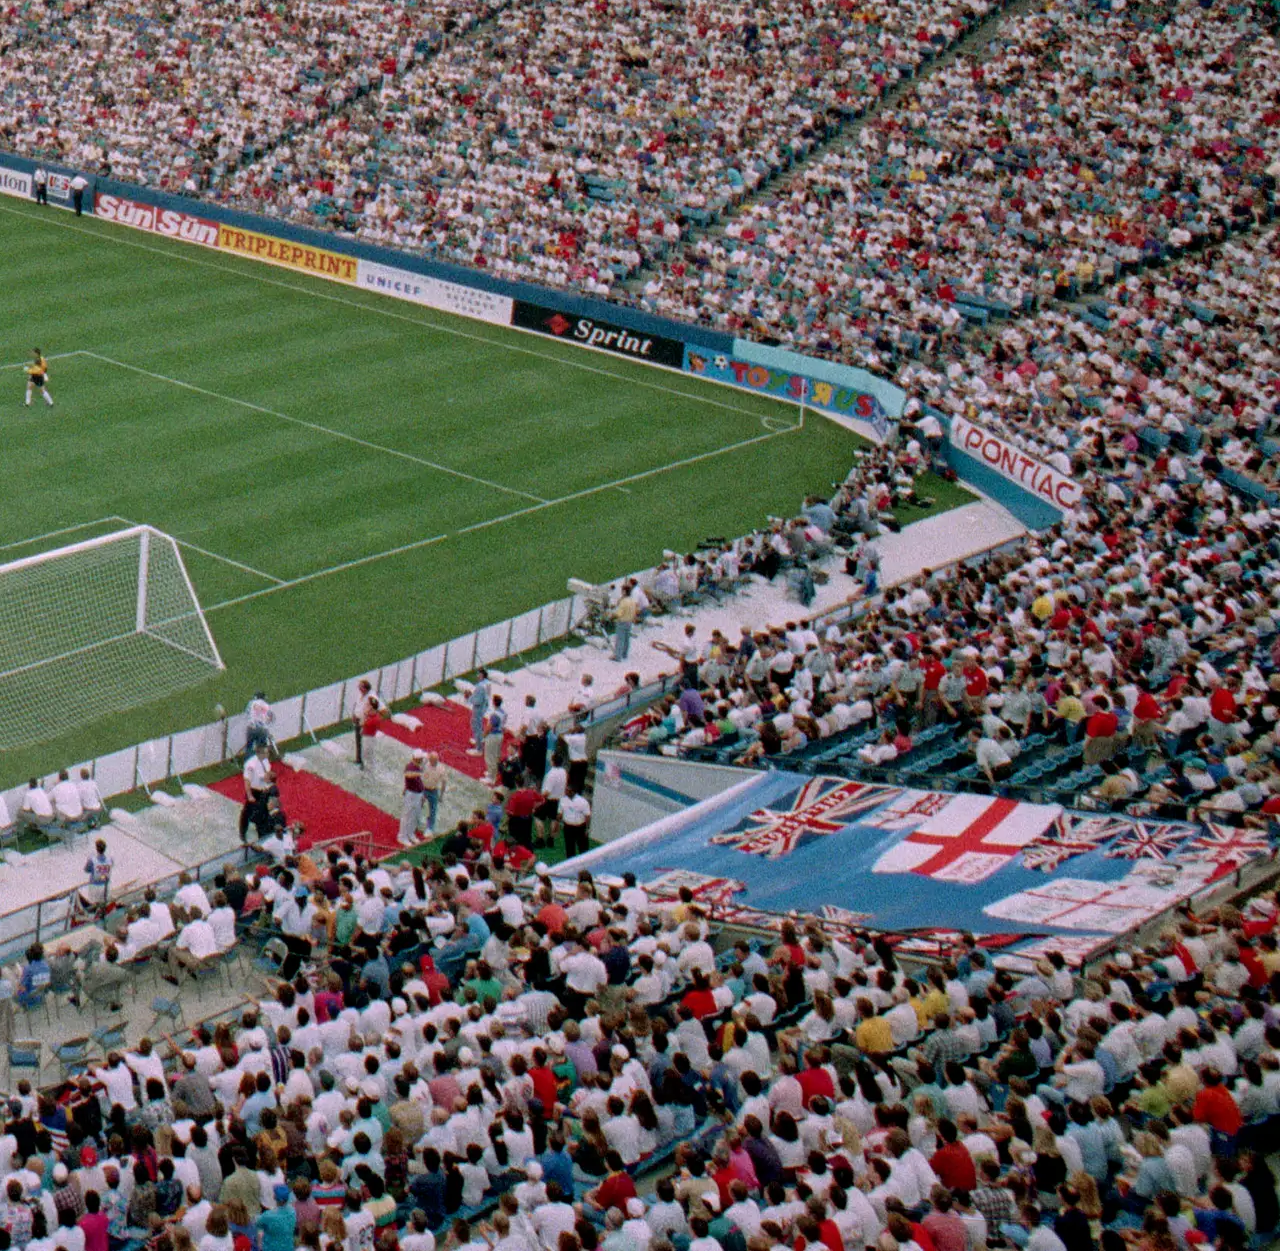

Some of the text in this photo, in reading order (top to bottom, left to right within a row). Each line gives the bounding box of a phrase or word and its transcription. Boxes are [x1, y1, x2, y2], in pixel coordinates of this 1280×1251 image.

[96, 194, 219, 245] Sün Sün
[221, 227, 357, 280] TRIPLEPRINT
[366, 273, 421, 297] UNICEF
[573, 318, 652, 355] Sprint
[729, 359, 808, 400] TOYS
[835, 391, 874, 418] US
[964, 426, 1077, 510] PONTIAC
[748, 789, 850, 849] CHELMSFORD
